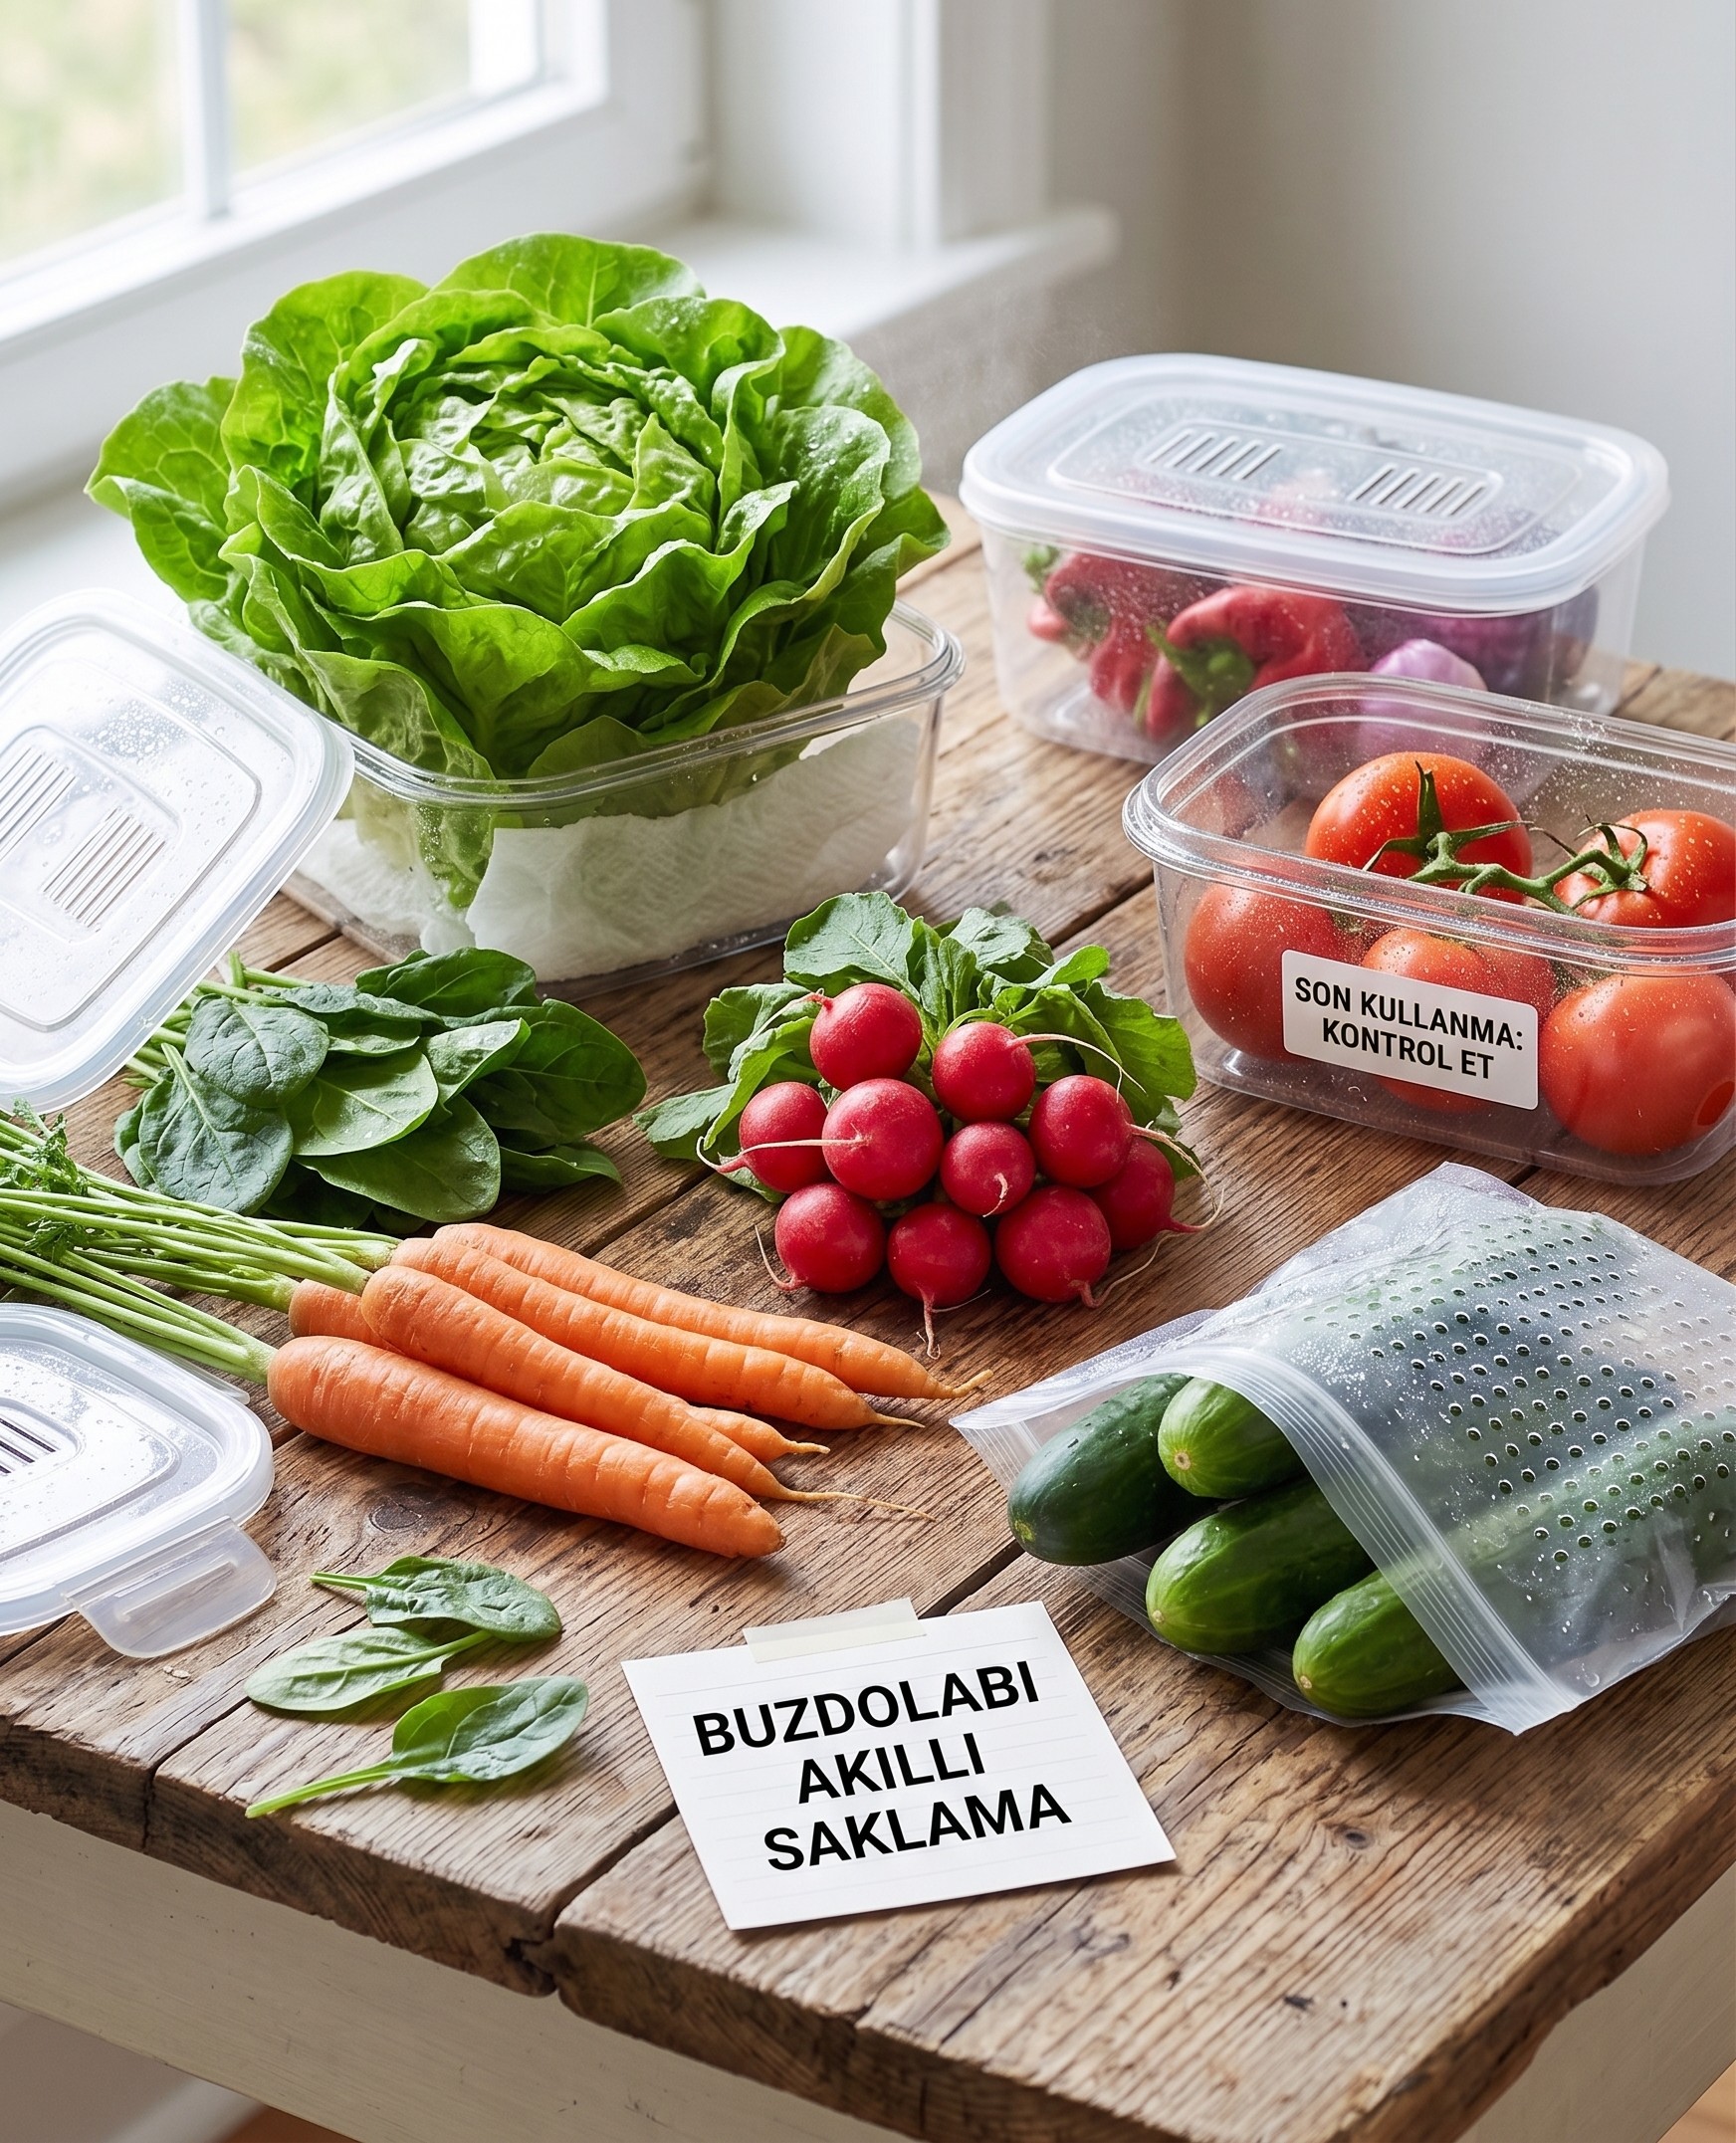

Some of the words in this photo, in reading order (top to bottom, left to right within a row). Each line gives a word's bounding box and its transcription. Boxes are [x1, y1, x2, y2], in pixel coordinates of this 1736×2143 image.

[1294, 976, 1352, 1013] SON
[1361, 990, 1524, 1051] KULLANMA:
[1322, 1017, 1453, 1071] KONTROL
[1460, 1049, 1495, 1080] ET
[692, 1660, 1039, 1757] BUZDOLABI
[798, 1732, 985, 1805] AKILLI
[763, 1783, 1072, 1871] SAKLAMA
